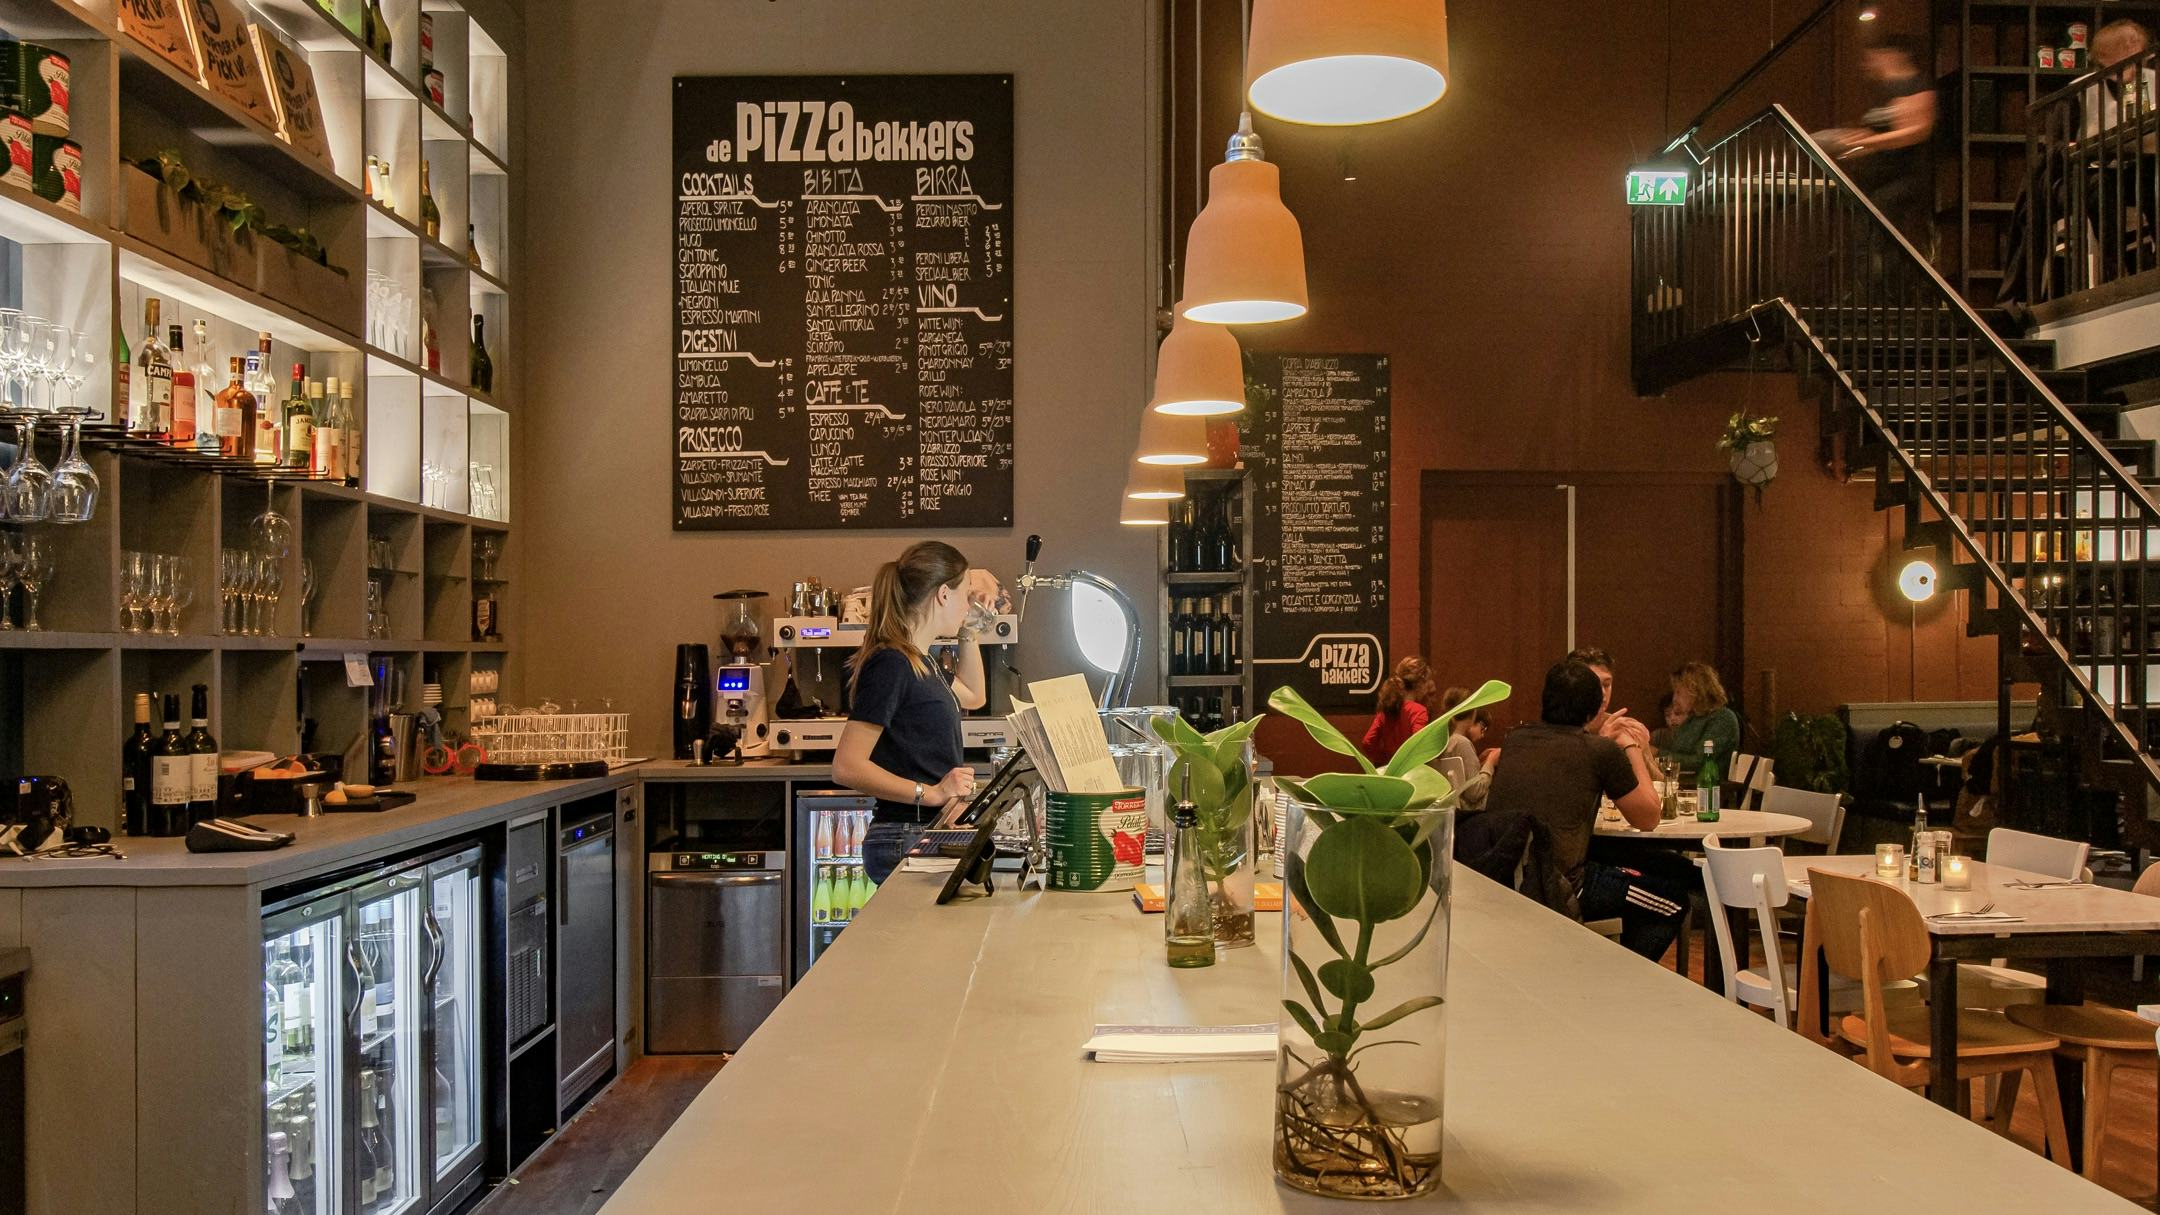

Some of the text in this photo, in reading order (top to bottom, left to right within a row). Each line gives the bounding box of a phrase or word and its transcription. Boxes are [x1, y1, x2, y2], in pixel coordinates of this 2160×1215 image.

[706, 139, 731, 162] de
[856, 121, 974, 161] bakkers
[682, 173, 754, 195] COCKTAILS
[804, 167, 864, 195] BIBITA
[916, 164, 973, 195] BIRRA
[681, 202, 743, 216] APEROL SPRITZ
[806, 201, 860, 214] ARANCIATA
[916, 203, 978, 216] PERONI NASTRO
[679, 217, 757, 232] PROSECCO LIMONCELLO
[807, 215, 853, 228] LIMONATA
[916, 216, 971, 228] AZZURRO BIER
[679, 233, 702, 248] HUGO
[806, 230, 847, 243] CHINOTTO
[679, 249, 719, 262] GIN TONIC
[805, 243, 885, 257] ARANCIATA ROSSA
[806, 258, 869, 272] GINGER BEER
[916, 252, 970, 265] PERONI LIBERA
[916, 267, 972, 281] SPECIAAL BIER
[680, 280, 740, 293] ITALIAN MULE
[805, 275, 835, 289] TONIC
[681, 296, 719, 309] NEGRONI
[831, 290, 866, 303] PANNA
[918, 284, 958, 308] VINO
[806, 304, 879, 317] SAN PELLEGRINO
[681, 310, 760, 325] ESPRESSO MARTINI
[918, 318, 942, 330] WITTE
[806, 319, 875, 332] SANTA VITTORIA
[682, 329, 737, 352] DIGESTIVI
[806, 341, 844, 353] SCIROPPO
[918, 344, 968, 357] PINOT GRIGIO
[679, 360, 728, 371] LIMONCELLO
[918, 357, 974, 369] CHARDONNAY
[679, 374, 720, 387] SAMBUCA
[918, 371, 946, 382] GRILLO
[680, 391, 728, 404] AMARETTO
[919, 386, 939, 398] RODE
[920, 401, 943, 414] NERO
[809, 413, 849, 426] ESPRESSO
[920, 416, 976, 429] NEGROAMARO
[679, 426, 742, 451] PROSECCO
[809, 427, 855, 441] CAPUCCINO
[920, 430, 994, 443] MONTEPULCIANO
[810, 442, 841, 457] LUNGO
[920, 456, 949, 468] RIPASSO
[949, 455, 988, 468] SUPERIORE
[810, 467, 848, 476] MACCHIATO
[920, 470, 938, 481] ROSE
[809, 477, 878, 490] ESPRESSO MACCHIATO
[920, 484, 972, 496] PINOT GRIGIO
[808, 490, 832, 502] THEE
[920, 497, 941, 510] ROSE
[1309, 659, 1320, 668] de
[1321, 668, 1369, 684] bakkers
